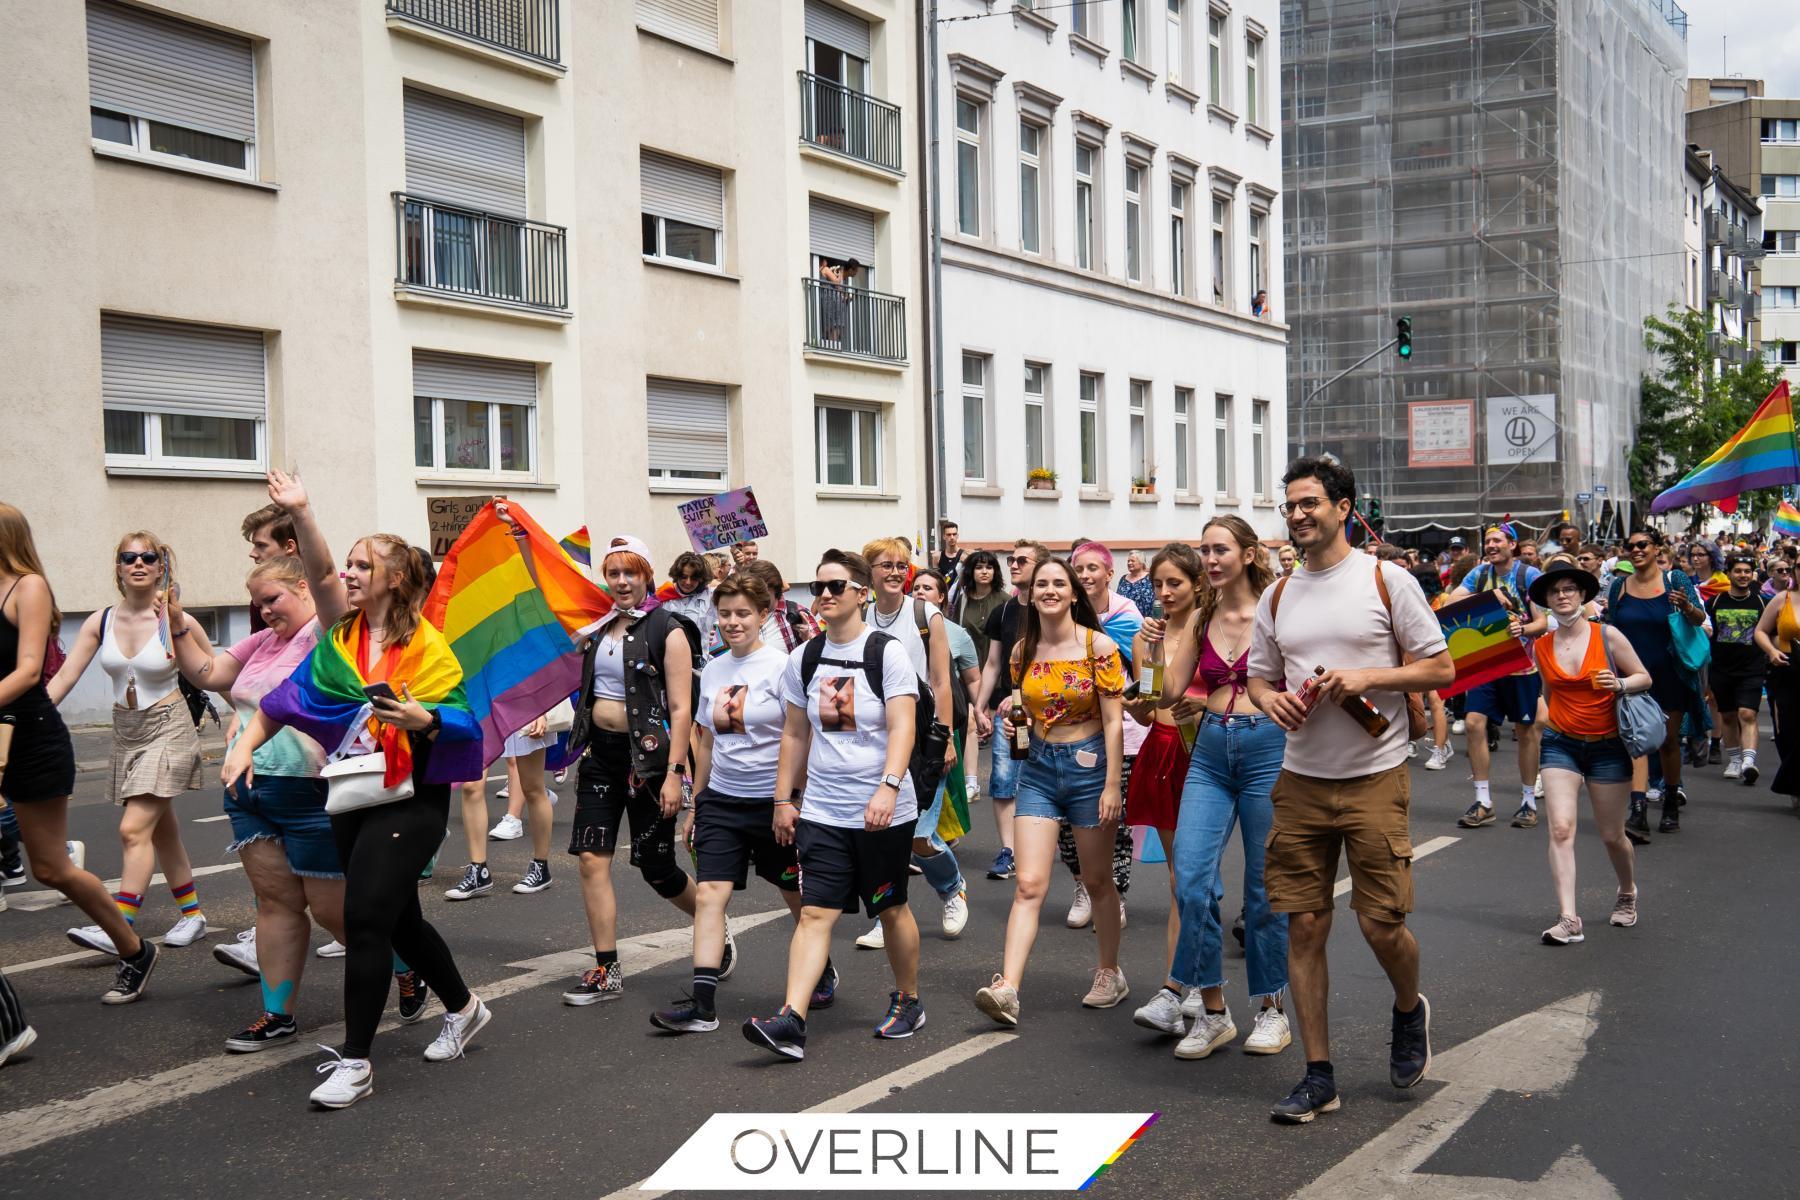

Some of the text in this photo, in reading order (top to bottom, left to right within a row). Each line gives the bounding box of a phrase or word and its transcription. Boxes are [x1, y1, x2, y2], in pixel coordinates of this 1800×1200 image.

[1502, 405, 1541, 416] WE ARE
[1508, 447, 1536, 457] OPEN
[431, 499, 459, 514] Girls
[678, 497, 716, 514] TAYLOR
[683, 509, 711, 524] SWIFT
[715, 512, 737, 524] YOUR
[431, 521, 440, 531] 2
[748, 523, 768, 539] 1989
[717, 531, 738, 544] GAY
